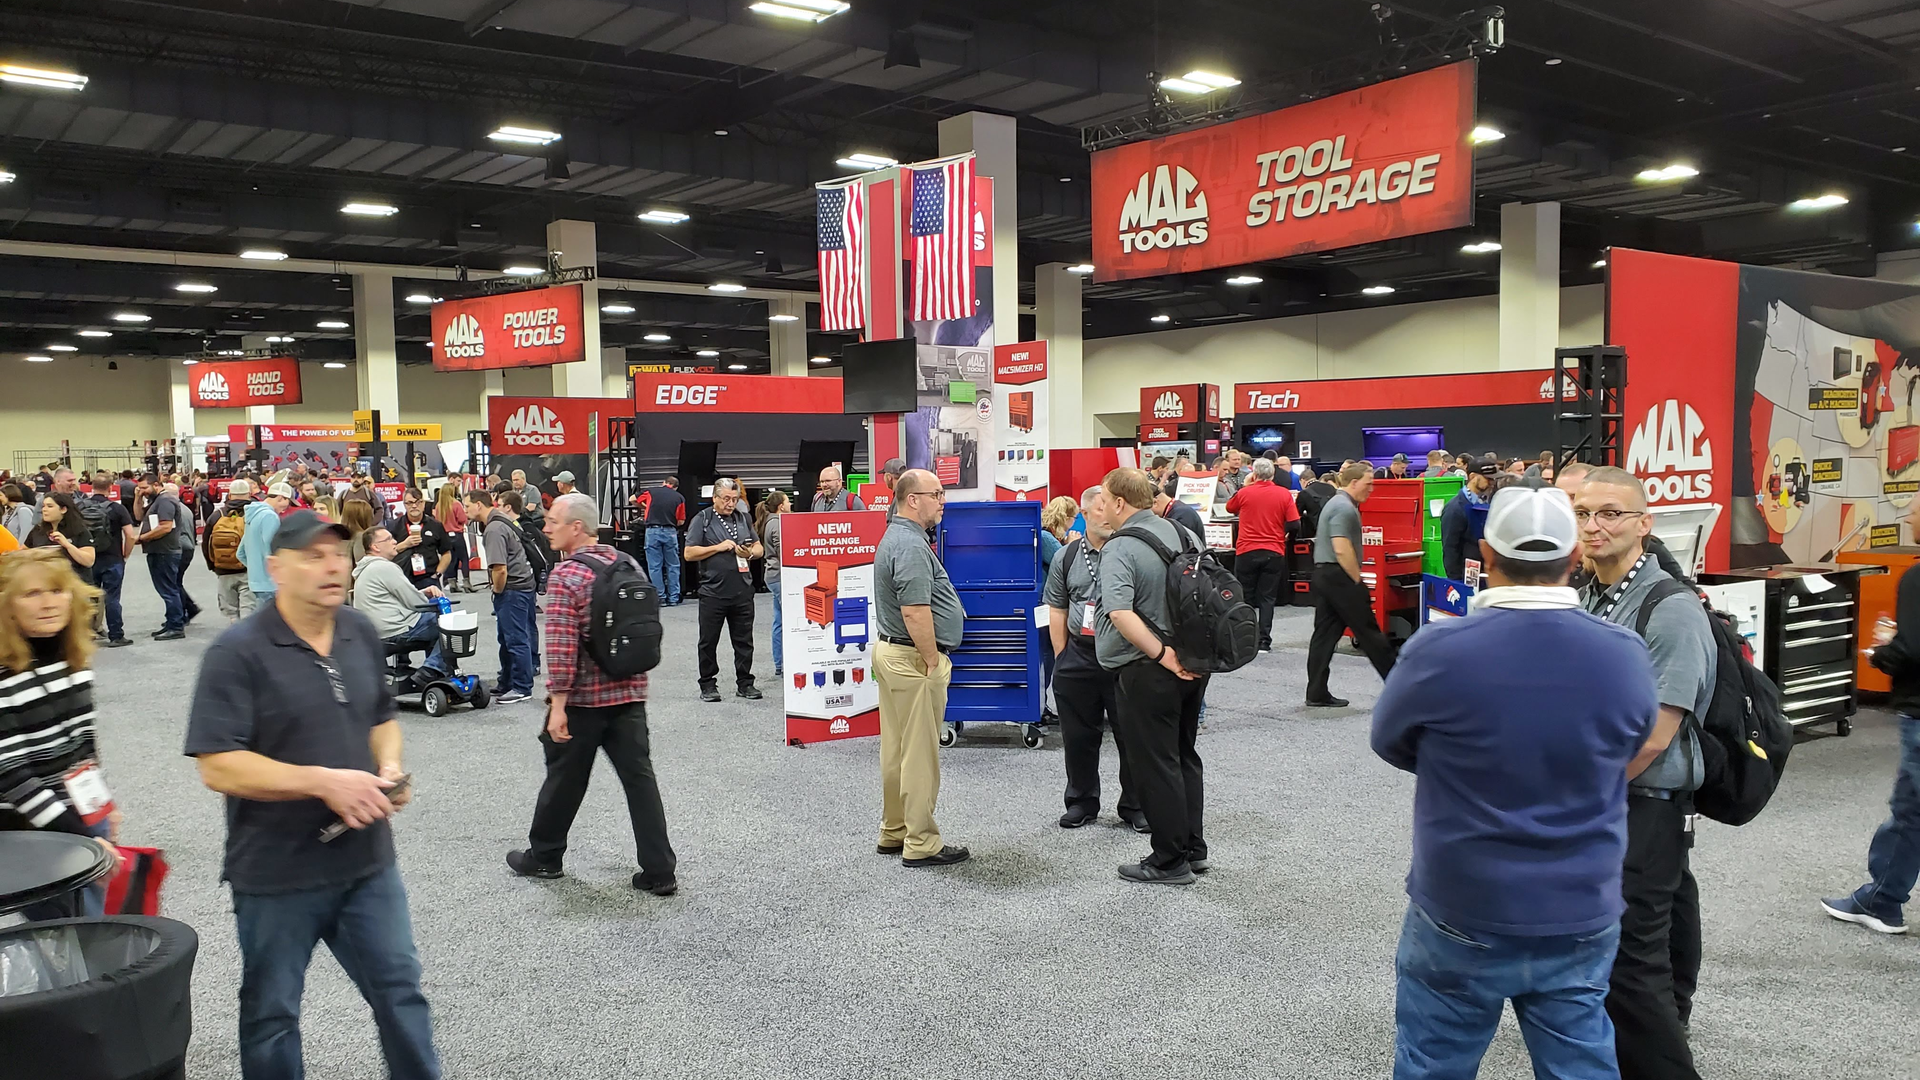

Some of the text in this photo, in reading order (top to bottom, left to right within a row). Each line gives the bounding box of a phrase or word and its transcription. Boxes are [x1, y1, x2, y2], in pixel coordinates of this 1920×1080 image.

[1256, 135, 1353, 187] TOOL
[1246, 154, 1441, 227] STORAGE
[1119, 165, 1209, 231] MAC
[1119, 221, 1209, 254] TOOLS
[503, 307, 558, 330] POWER
[444, 313, 484, 346] MAC
[512, 325, 566, 348] TOOLS
[444, 344, 485, 358] TOOLS
[1011, 352, 1029, 361] NEW!
[967, 353, 986, 367] MAC
[997, 363, 1044, 375] MACSIMIZER HD
[198, 371, 229, 392] MAC
[247, 371, 281, 384] HAND
[1540, 375, 1576, 392] MC
[198, 391, 229, 400] TOOLS
[248, 383, 285, 396] TOOLS
[1154, 391, 1183, 411] MAC
[1248, 390, 1299, 409] Tech
[504, 404, 564, 435] MAC
[1154, 409, 1183, 418] TOOLS
[299, 429, 327, 437] POWER
[329, 429, 340, 437] OF
[504, 434, 565, 446] TOOLS
[1626, 399, 1712, 475] MAC
[874, 495, 888, 503] 2019
[817, 522, 852, 535] NEW!
[810, 537, 860, 546] MID-RANGE
[793, 545, 876, 557] 28" UTILITY CARTS
[830, 718, 850, 730] MAC
